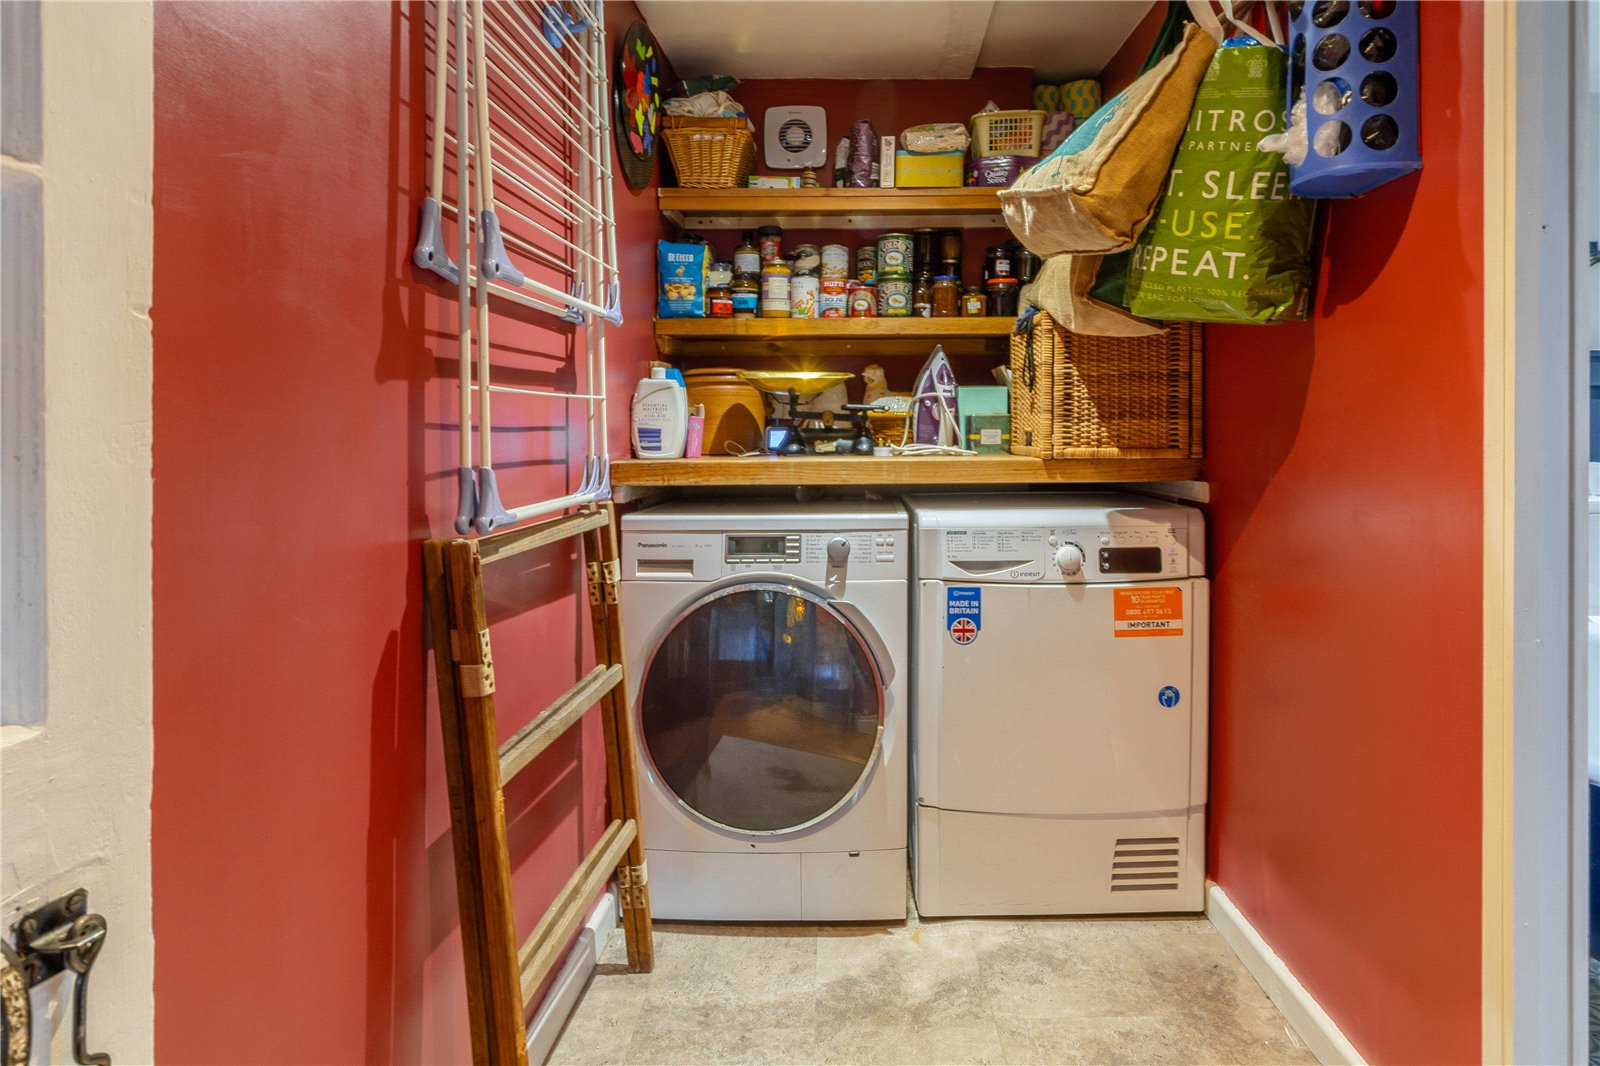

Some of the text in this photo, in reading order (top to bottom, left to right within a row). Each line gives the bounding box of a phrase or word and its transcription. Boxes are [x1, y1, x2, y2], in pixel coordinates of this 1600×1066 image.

[1187, 109, 1287, 132] ITRO
[1187, 141, 1261, 152] PARTNE
[1201, 170, 1300, 200] SLEE
[1132, 243, 1250, 280] REPEAT.
[949, 607, 979, 615] BRITAIN
[1127, 621, 1170, 629] IMPORTANT
